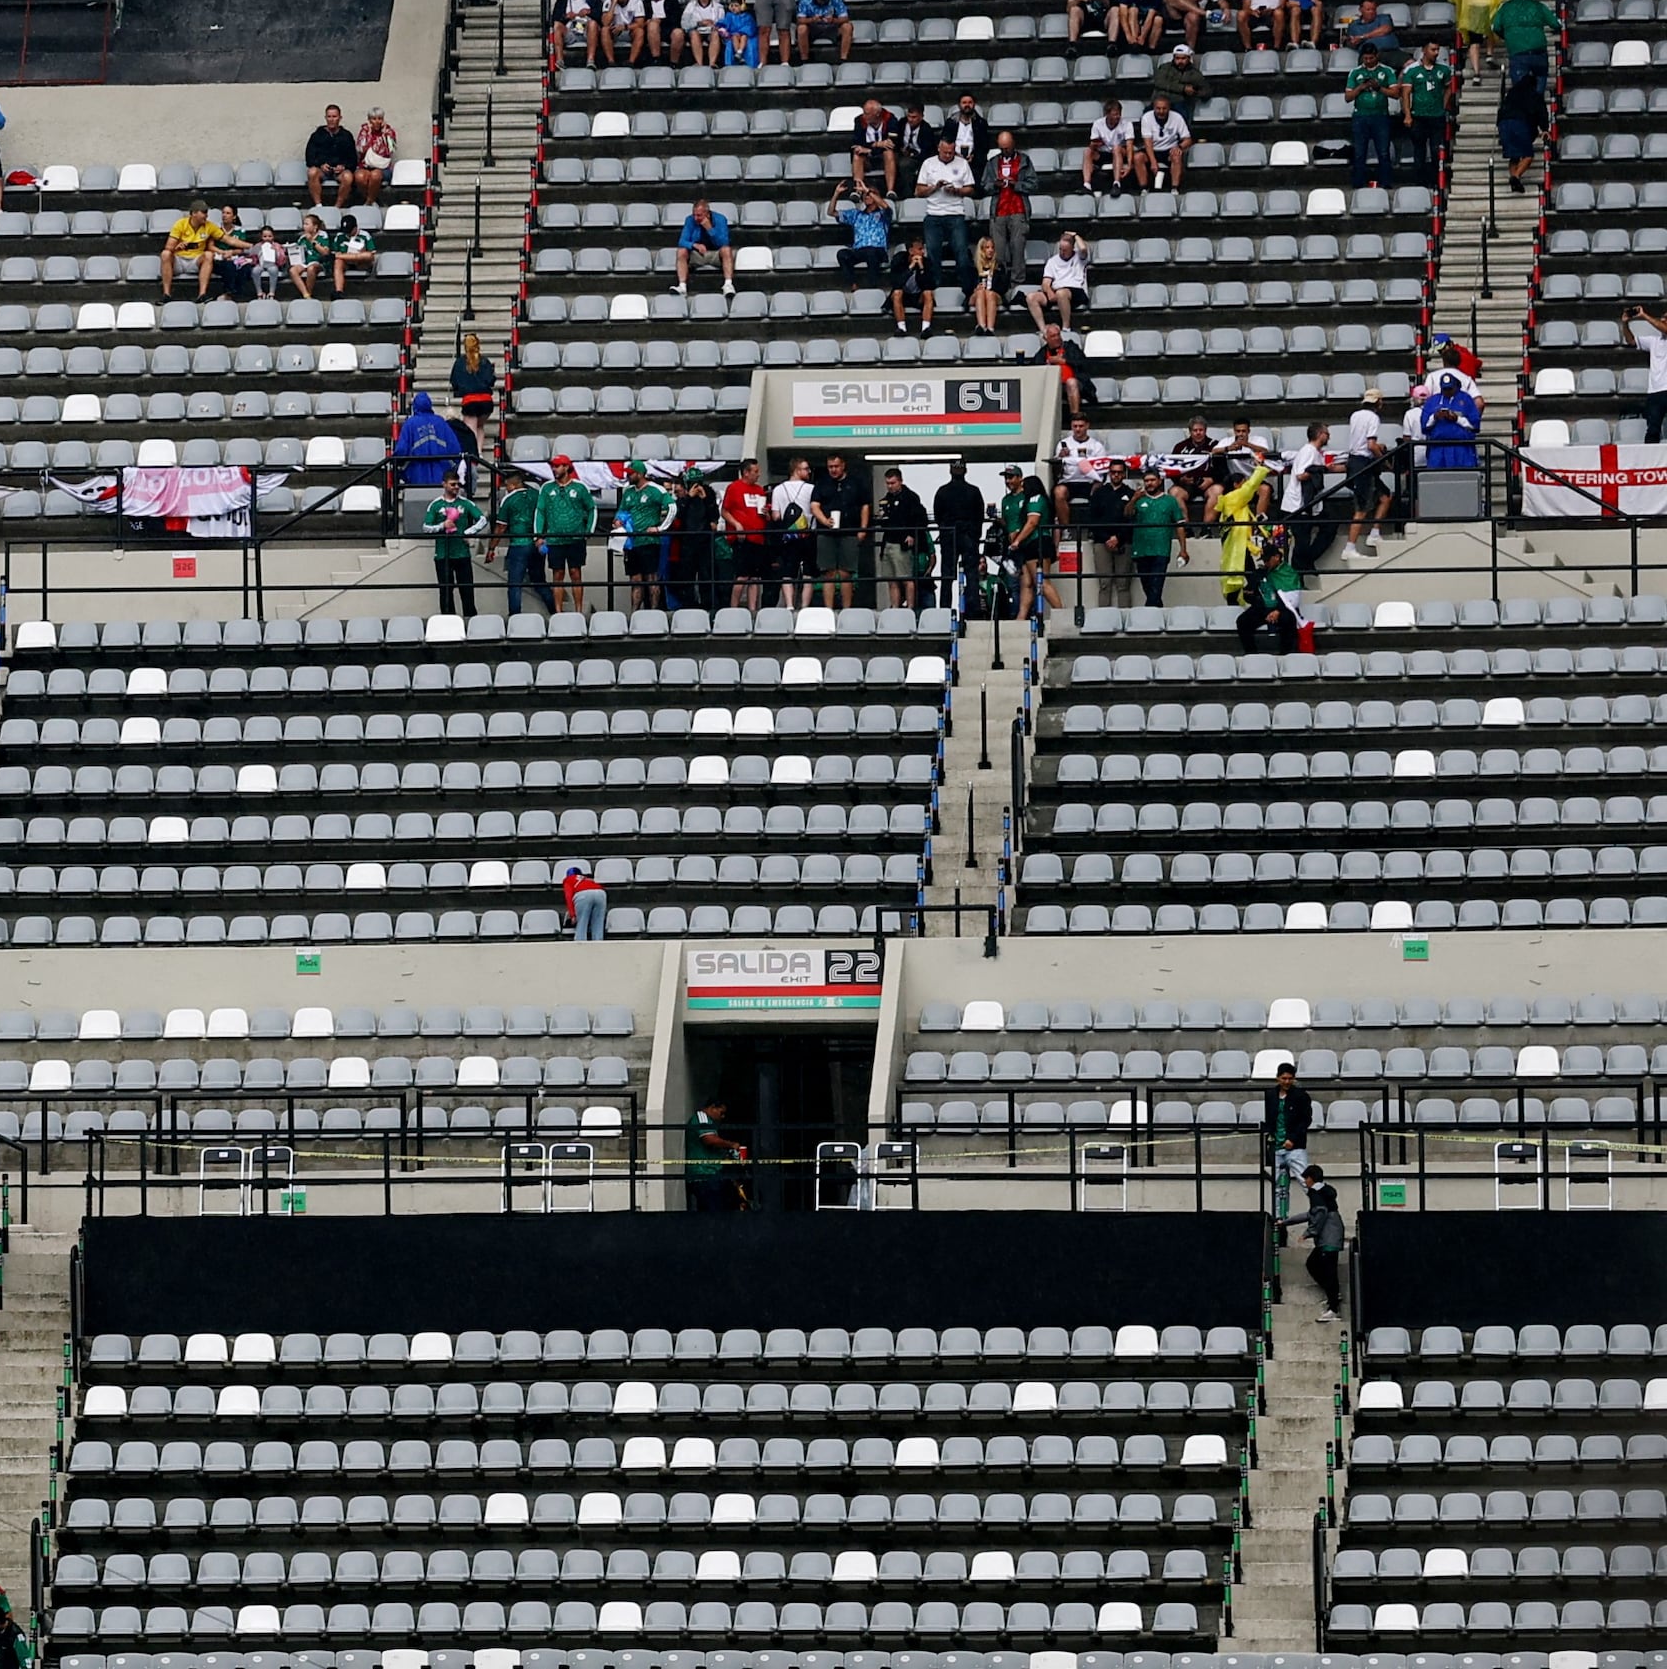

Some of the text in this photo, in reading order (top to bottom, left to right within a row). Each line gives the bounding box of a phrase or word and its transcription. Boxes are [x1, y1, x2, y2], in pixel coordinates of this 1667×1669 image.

[821, 383, 932, 405] SALIDA
[958, 382, 1009, 412] 64
[902, 405, 931, 413] EXIT
[852, 428, 877, 437] SALIDA
[695, 952, 812, 974] SALIDA
[828, 952, 881, 982] 22
[780, 975, 811, 983] EXIT
[728, 999, 755, 1008] SALIDA
